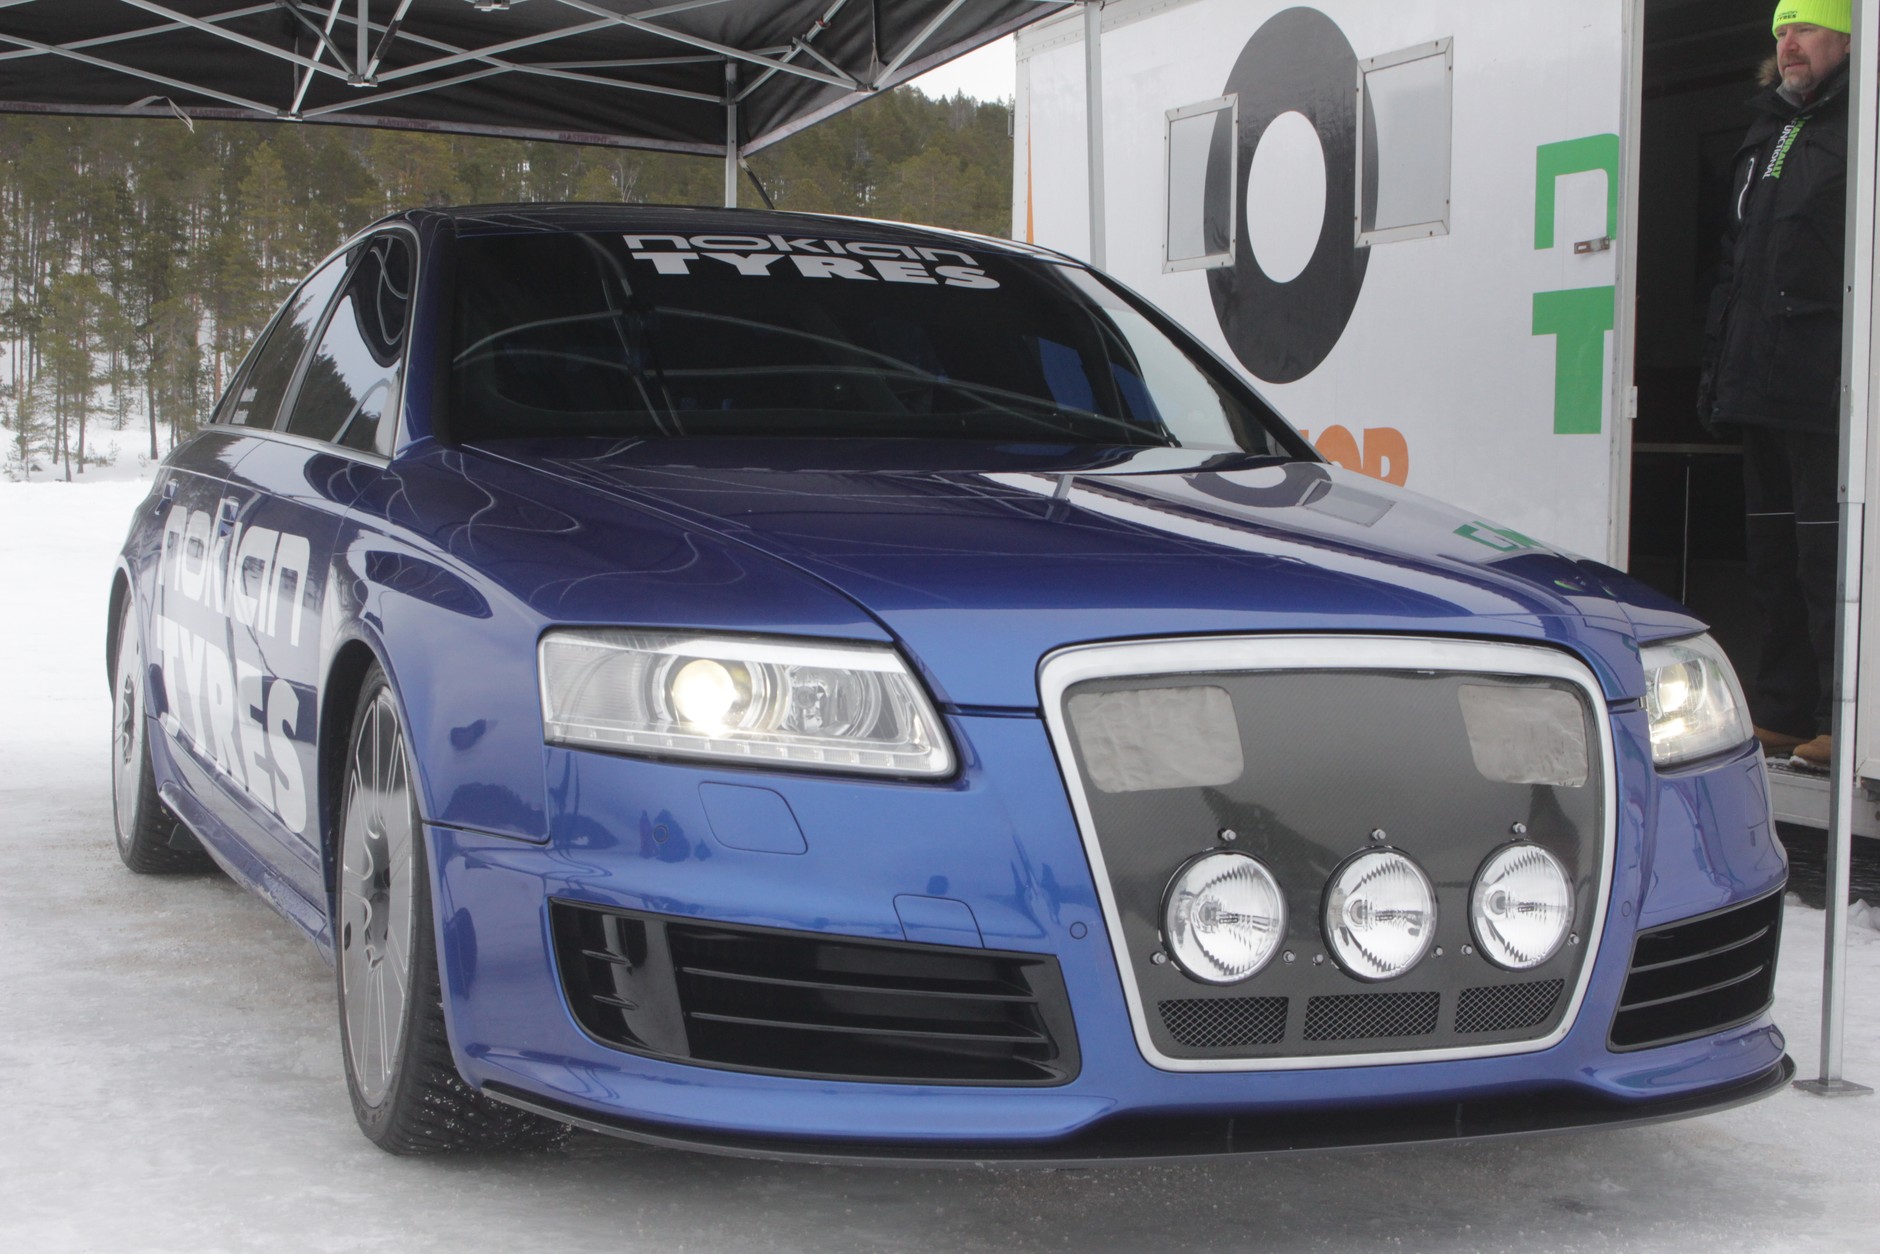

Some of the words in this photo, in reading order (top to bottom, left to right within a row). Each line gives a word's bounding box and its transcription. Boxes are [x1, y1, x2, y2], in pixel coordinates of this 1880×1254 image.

[1761, 119, 1797, 180] FUNCTIONAL
[1770, 118, 1806, 179] NATURALLY
[631, 251, 1001, 290] TYRES
[156, 614, 307, 834] TYRES
